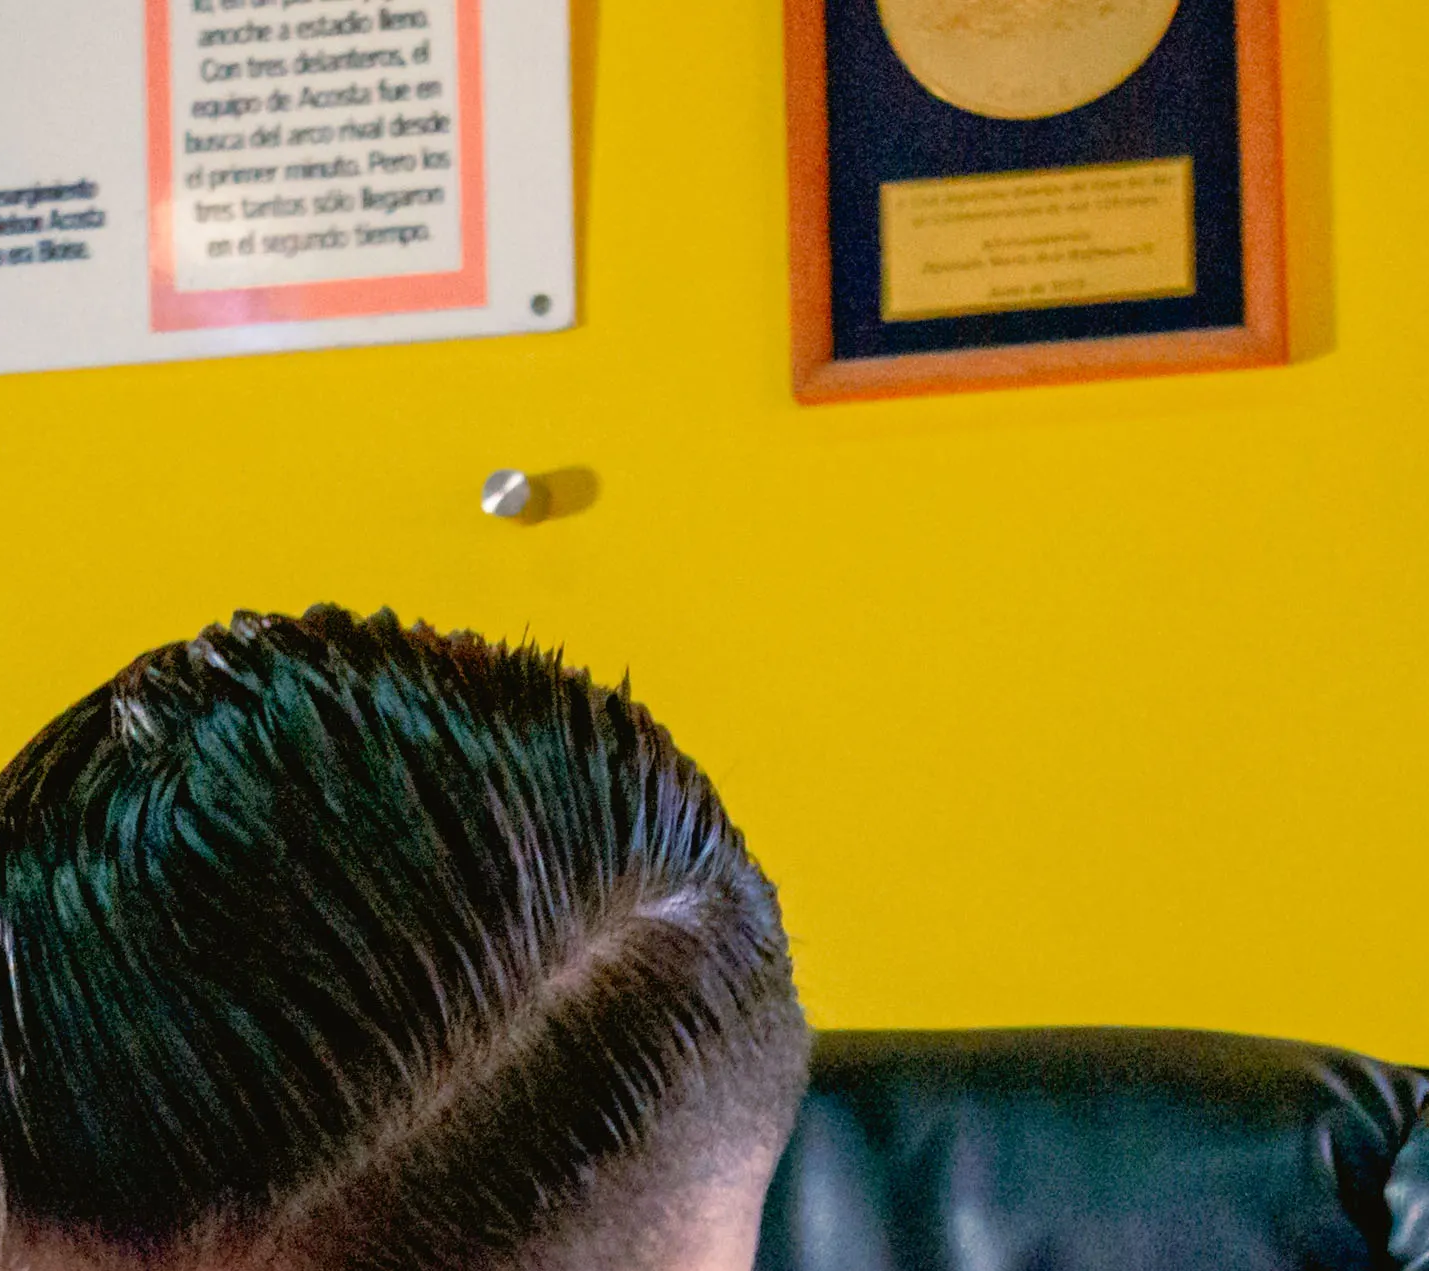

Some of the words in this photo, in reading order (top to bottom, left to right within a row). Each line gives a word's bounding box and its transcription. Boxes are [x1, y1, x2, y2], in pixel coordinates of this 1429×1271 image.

[199, 21, 272, 47] anoche
[278, 24, 290, 40] a
[296, 11, 373, 39] estadio
[201, 58, 240, 83] Con
[247, 57, 289, 78] tres
[412, 39, 430, 64] el
[192, 94, 261, 120] equipo
[267, 87, 291, 113] de
[299, 84, 372, 108] Acosta
[378, 78, 411, 102] fue
[416, 80, 442, 99] en
[185, 129, 245, 153] busca
[249, 123, 282, 147] del
[287, 126, 336, 146] arco
[338, 116, 385, 140] rival
[390, 110, 450, 137] desde
[186, 166, 204, 189] el
[209, 165, 278, 190] primer
[367, 151, 418, 173] Pero
[422, 149, 451, 170] los
[195, 200, 236, 223] tres
[241, 195, 307, 218] tantos
[361, 185, 445, 215] llegaron
[207, 239, 233, 258] en
[238, 232, 255, 256] el
[261, 228, 349, 258] segundo
